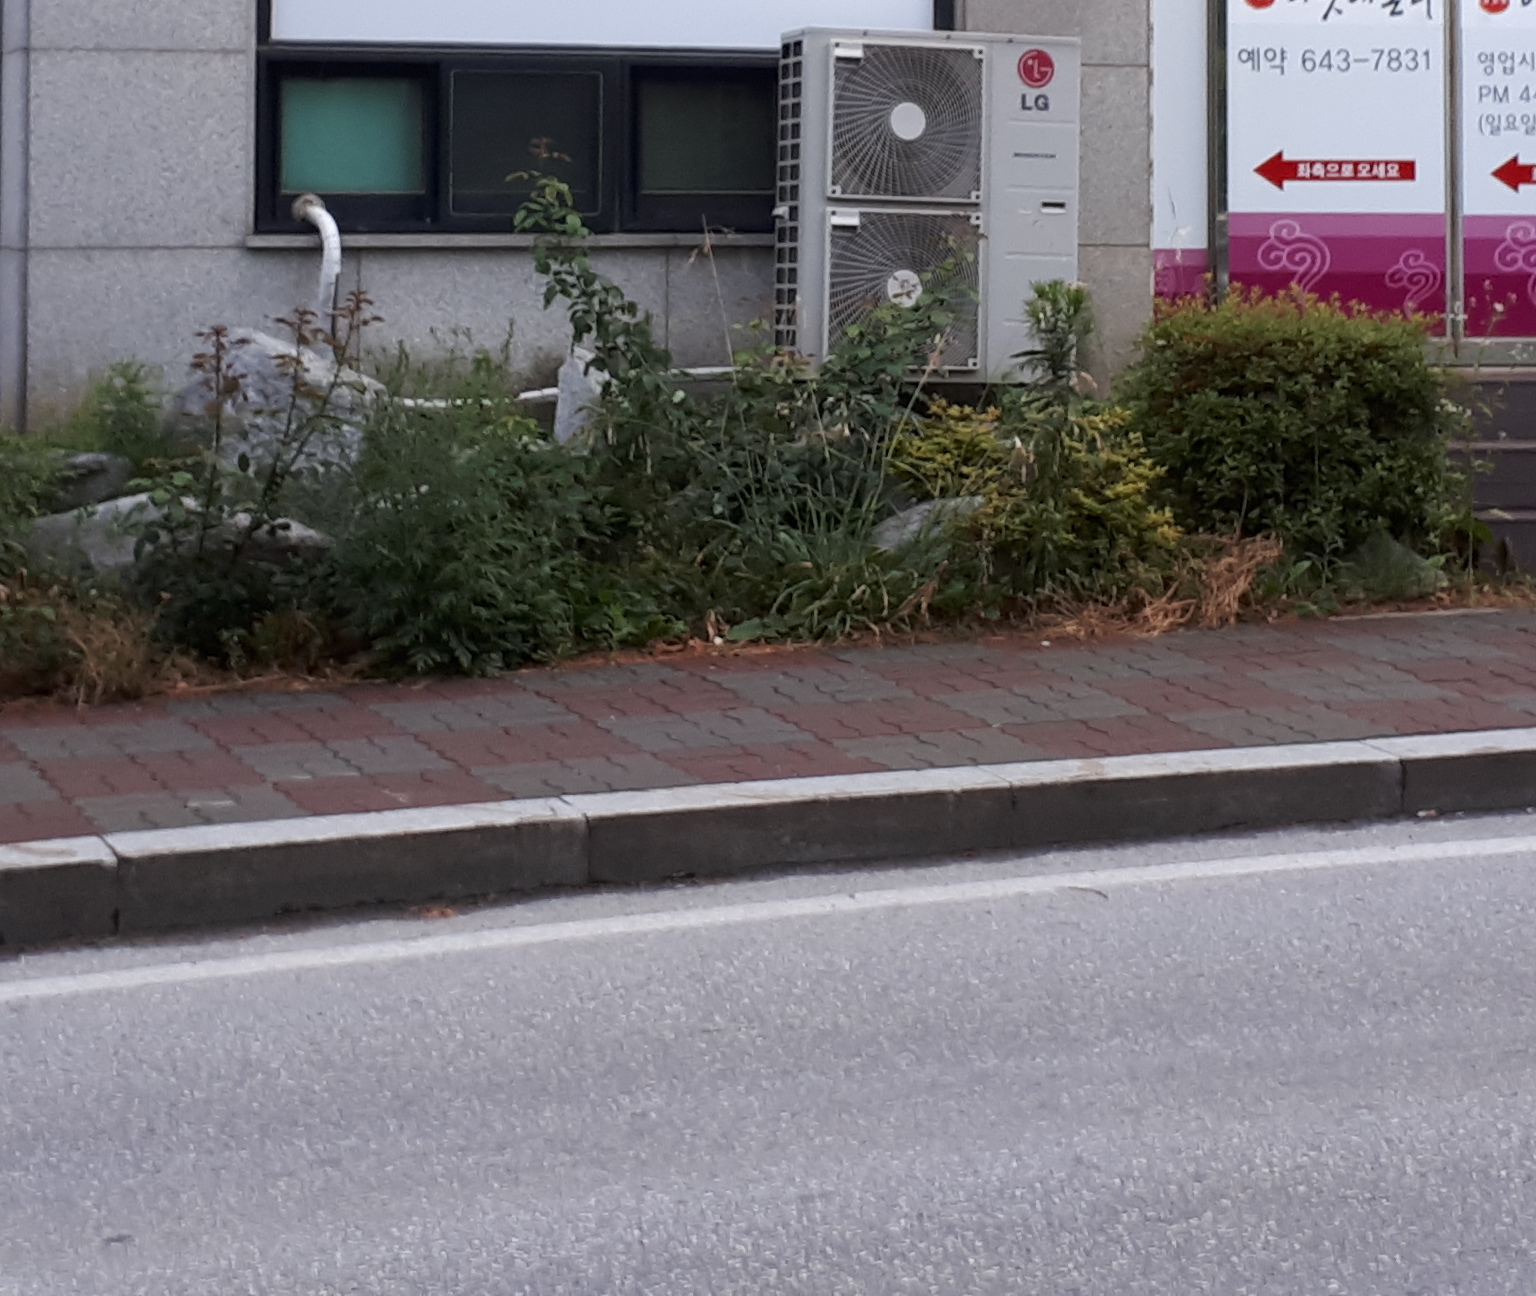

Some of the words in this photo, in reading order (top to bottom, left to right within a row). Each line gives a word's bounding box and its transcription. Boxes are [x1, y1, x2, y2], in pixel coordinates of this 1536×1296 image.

[1238, 47, 1287, 75] 예약
[1301, 48, 1431, 72] 643-7831
[1021, 93, 1050, 111] LG
[1478, 85, 1510, 104] PM
